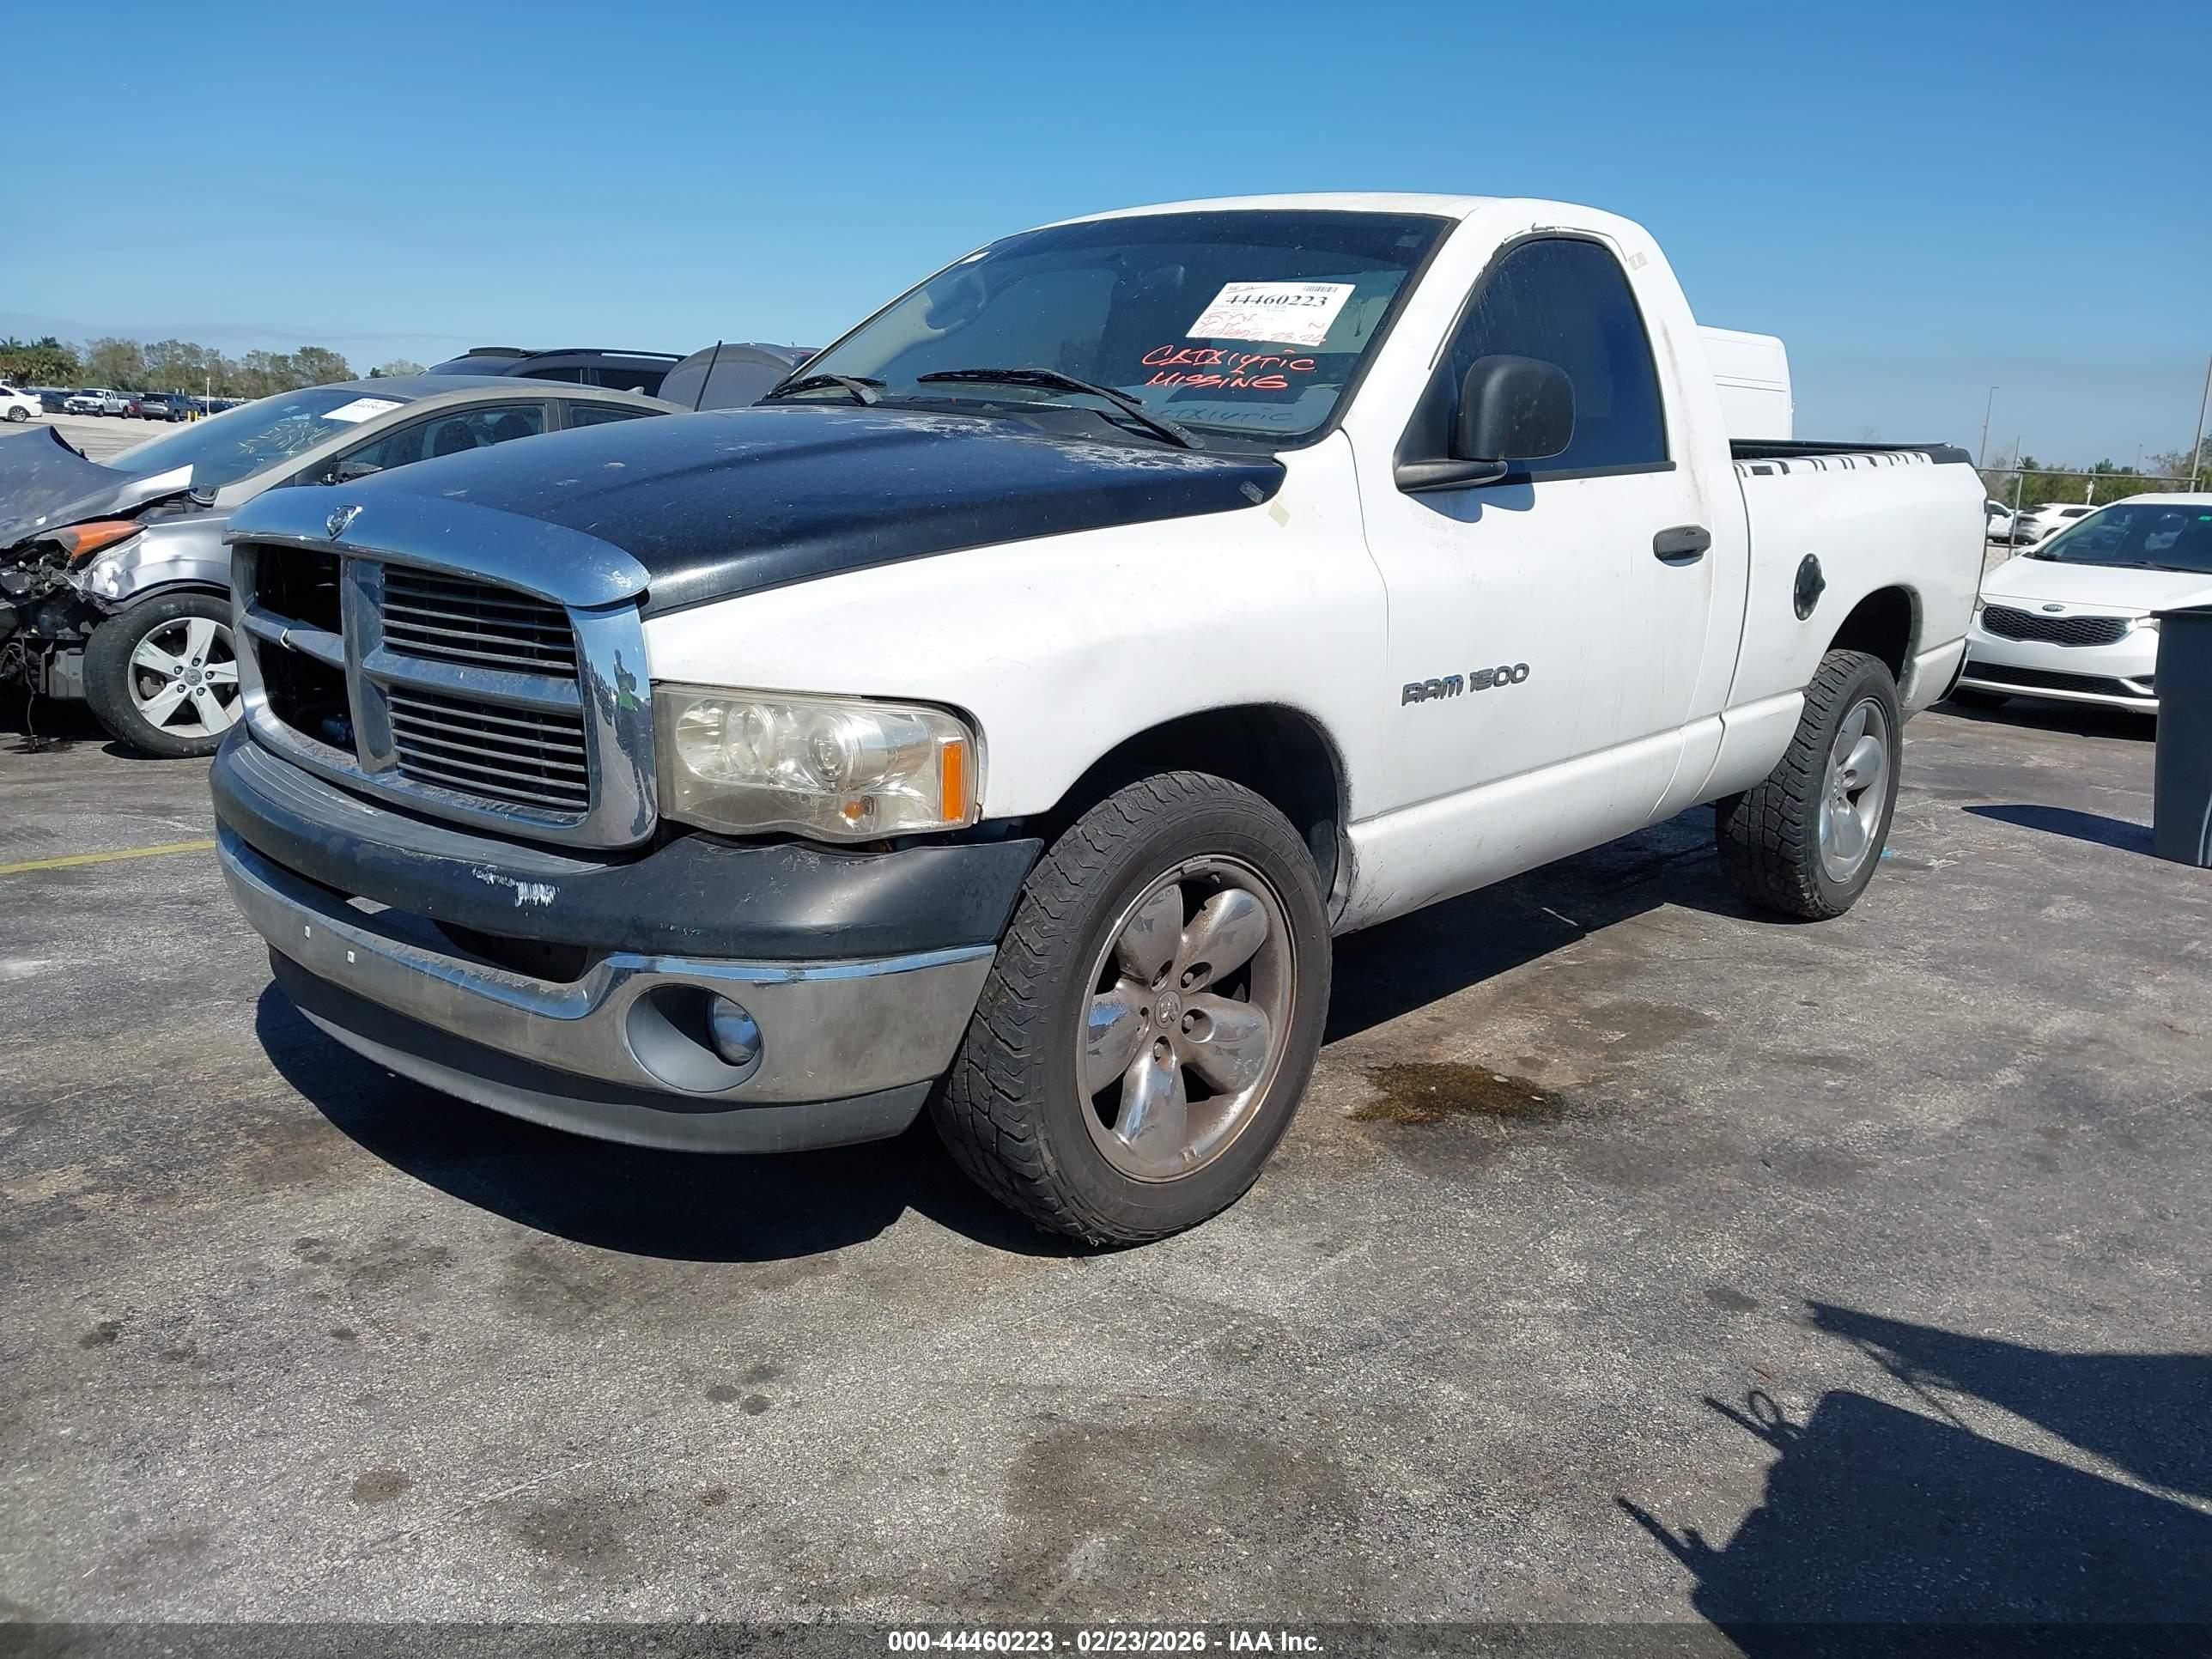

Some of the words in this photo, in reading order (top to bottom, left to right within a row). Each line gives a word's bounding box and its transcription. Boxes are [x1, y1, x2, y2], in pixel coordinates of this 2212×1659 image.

[1225, 294, 1328, 307] 44460223
[1146, 372, 1288, 389] MISSING
[1401, 674, 1464, 707] RAM
[1469, 662, 1530, 693] 1500
